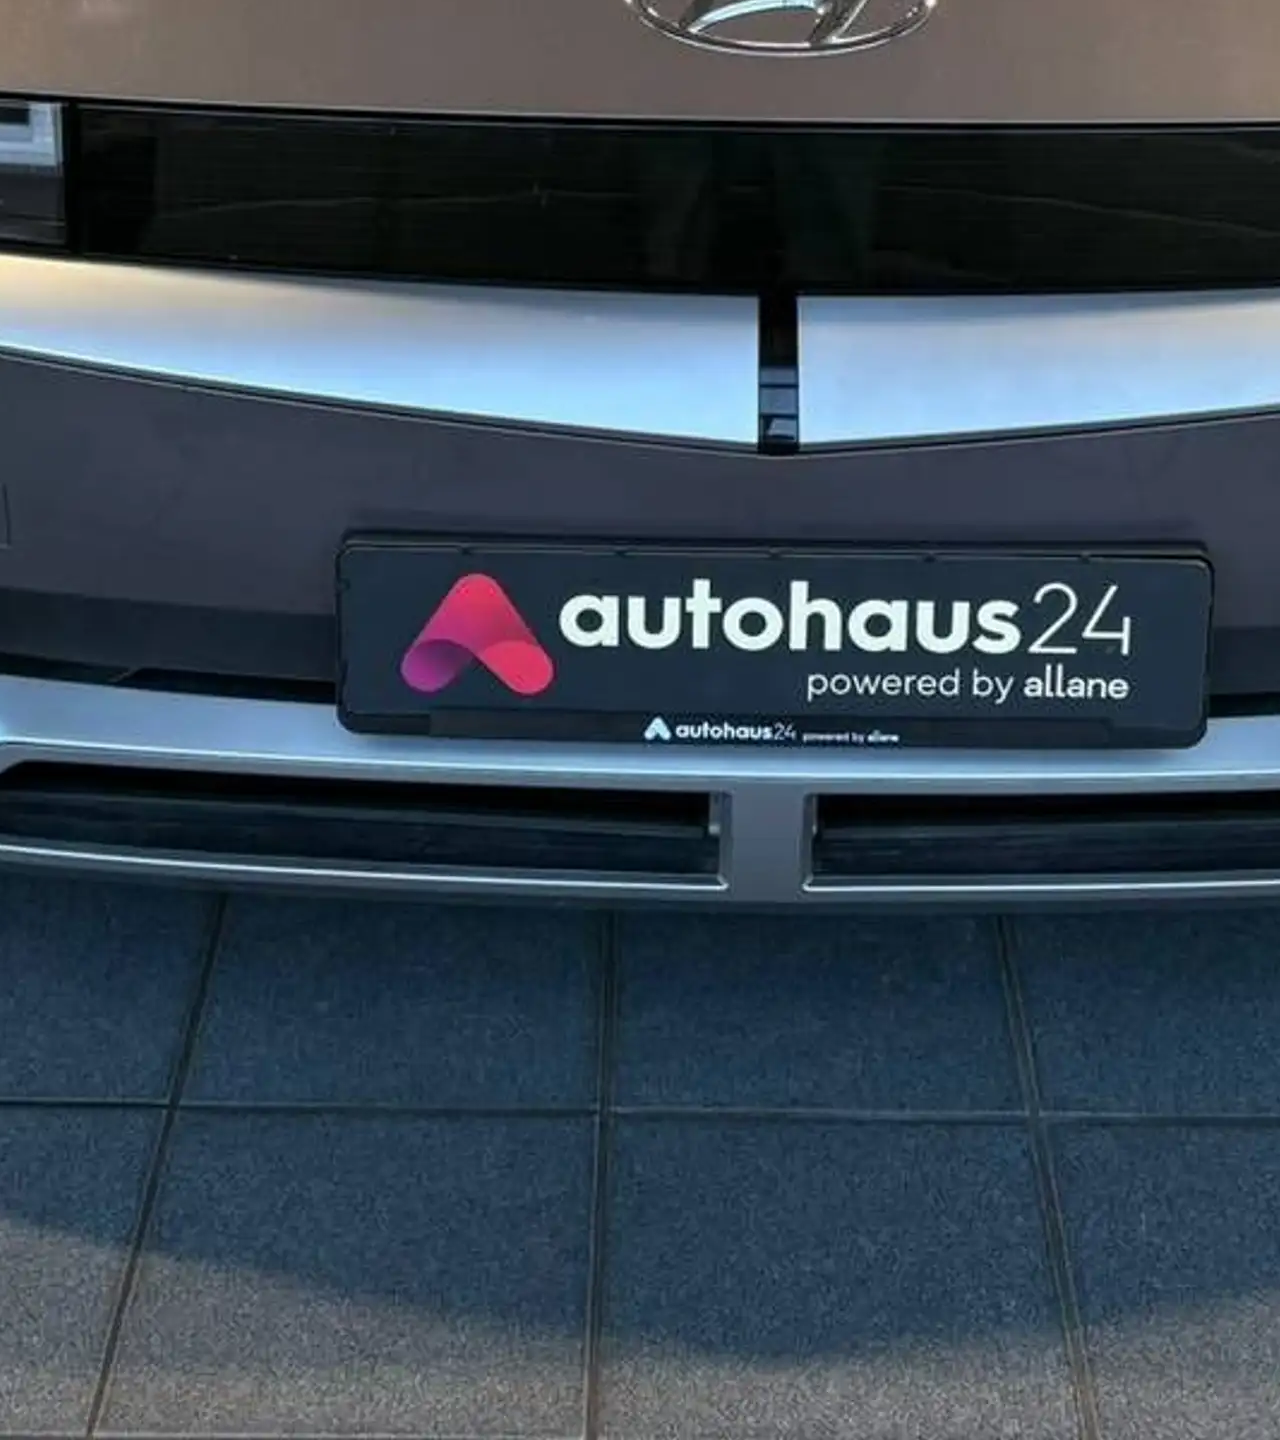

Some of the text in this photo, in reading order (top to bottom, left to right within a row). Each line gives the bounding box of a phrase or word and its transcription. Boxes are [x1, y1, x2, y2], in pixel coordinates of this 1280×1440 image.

[558, 578, 1132, 656] autohaus24
[807, 664, 1130, 703] powered by allane
[675, 721, 796, 741] autohaus24
